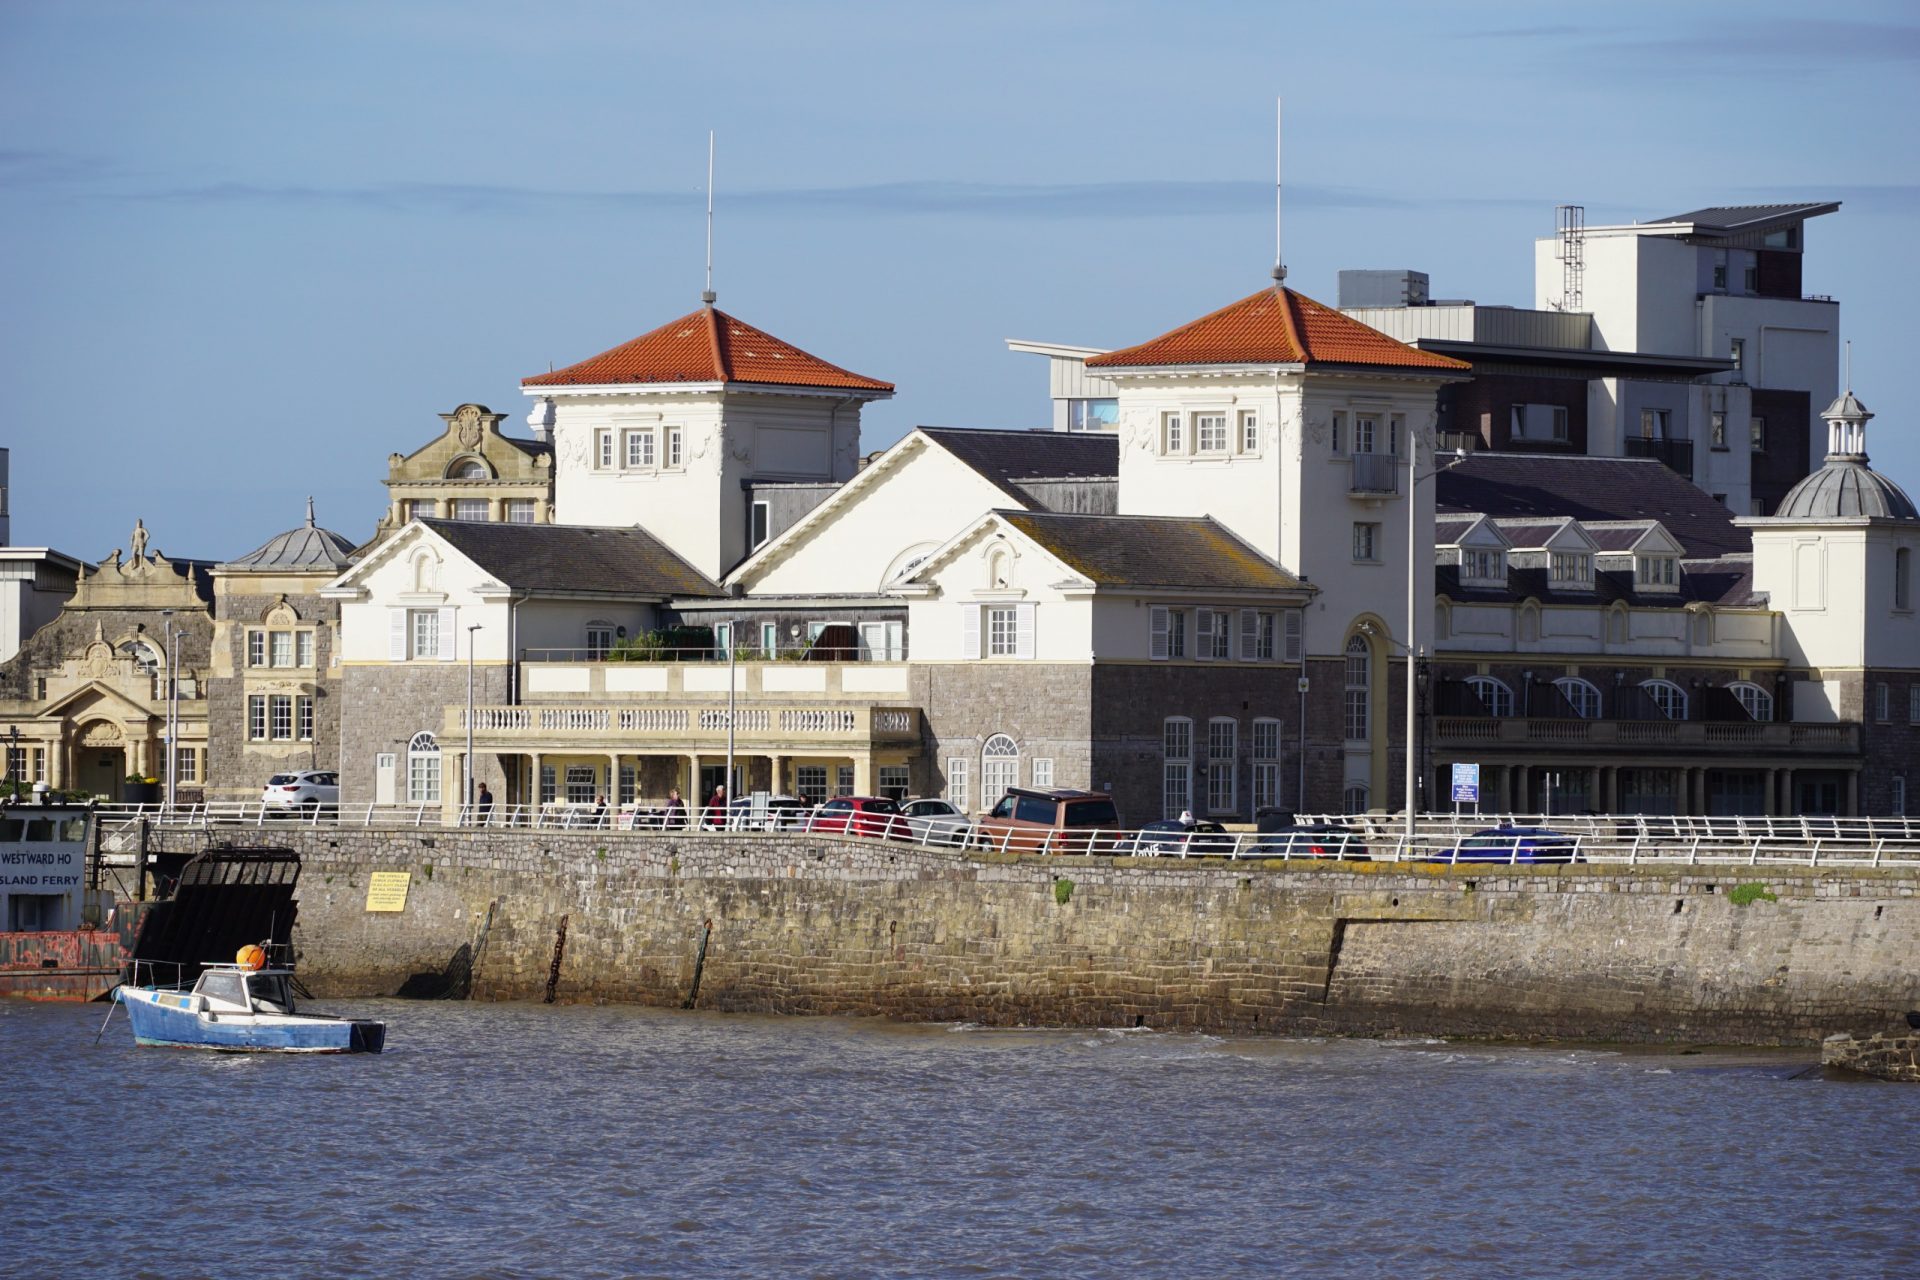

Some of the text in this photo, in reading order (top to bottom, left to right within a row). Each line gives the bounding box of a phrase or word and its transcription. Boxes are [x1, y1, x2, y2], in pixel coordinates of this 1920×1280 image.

[1, 853, 72, 865] WESTWARD HO
[42, 875, 79, 885] FERRY
